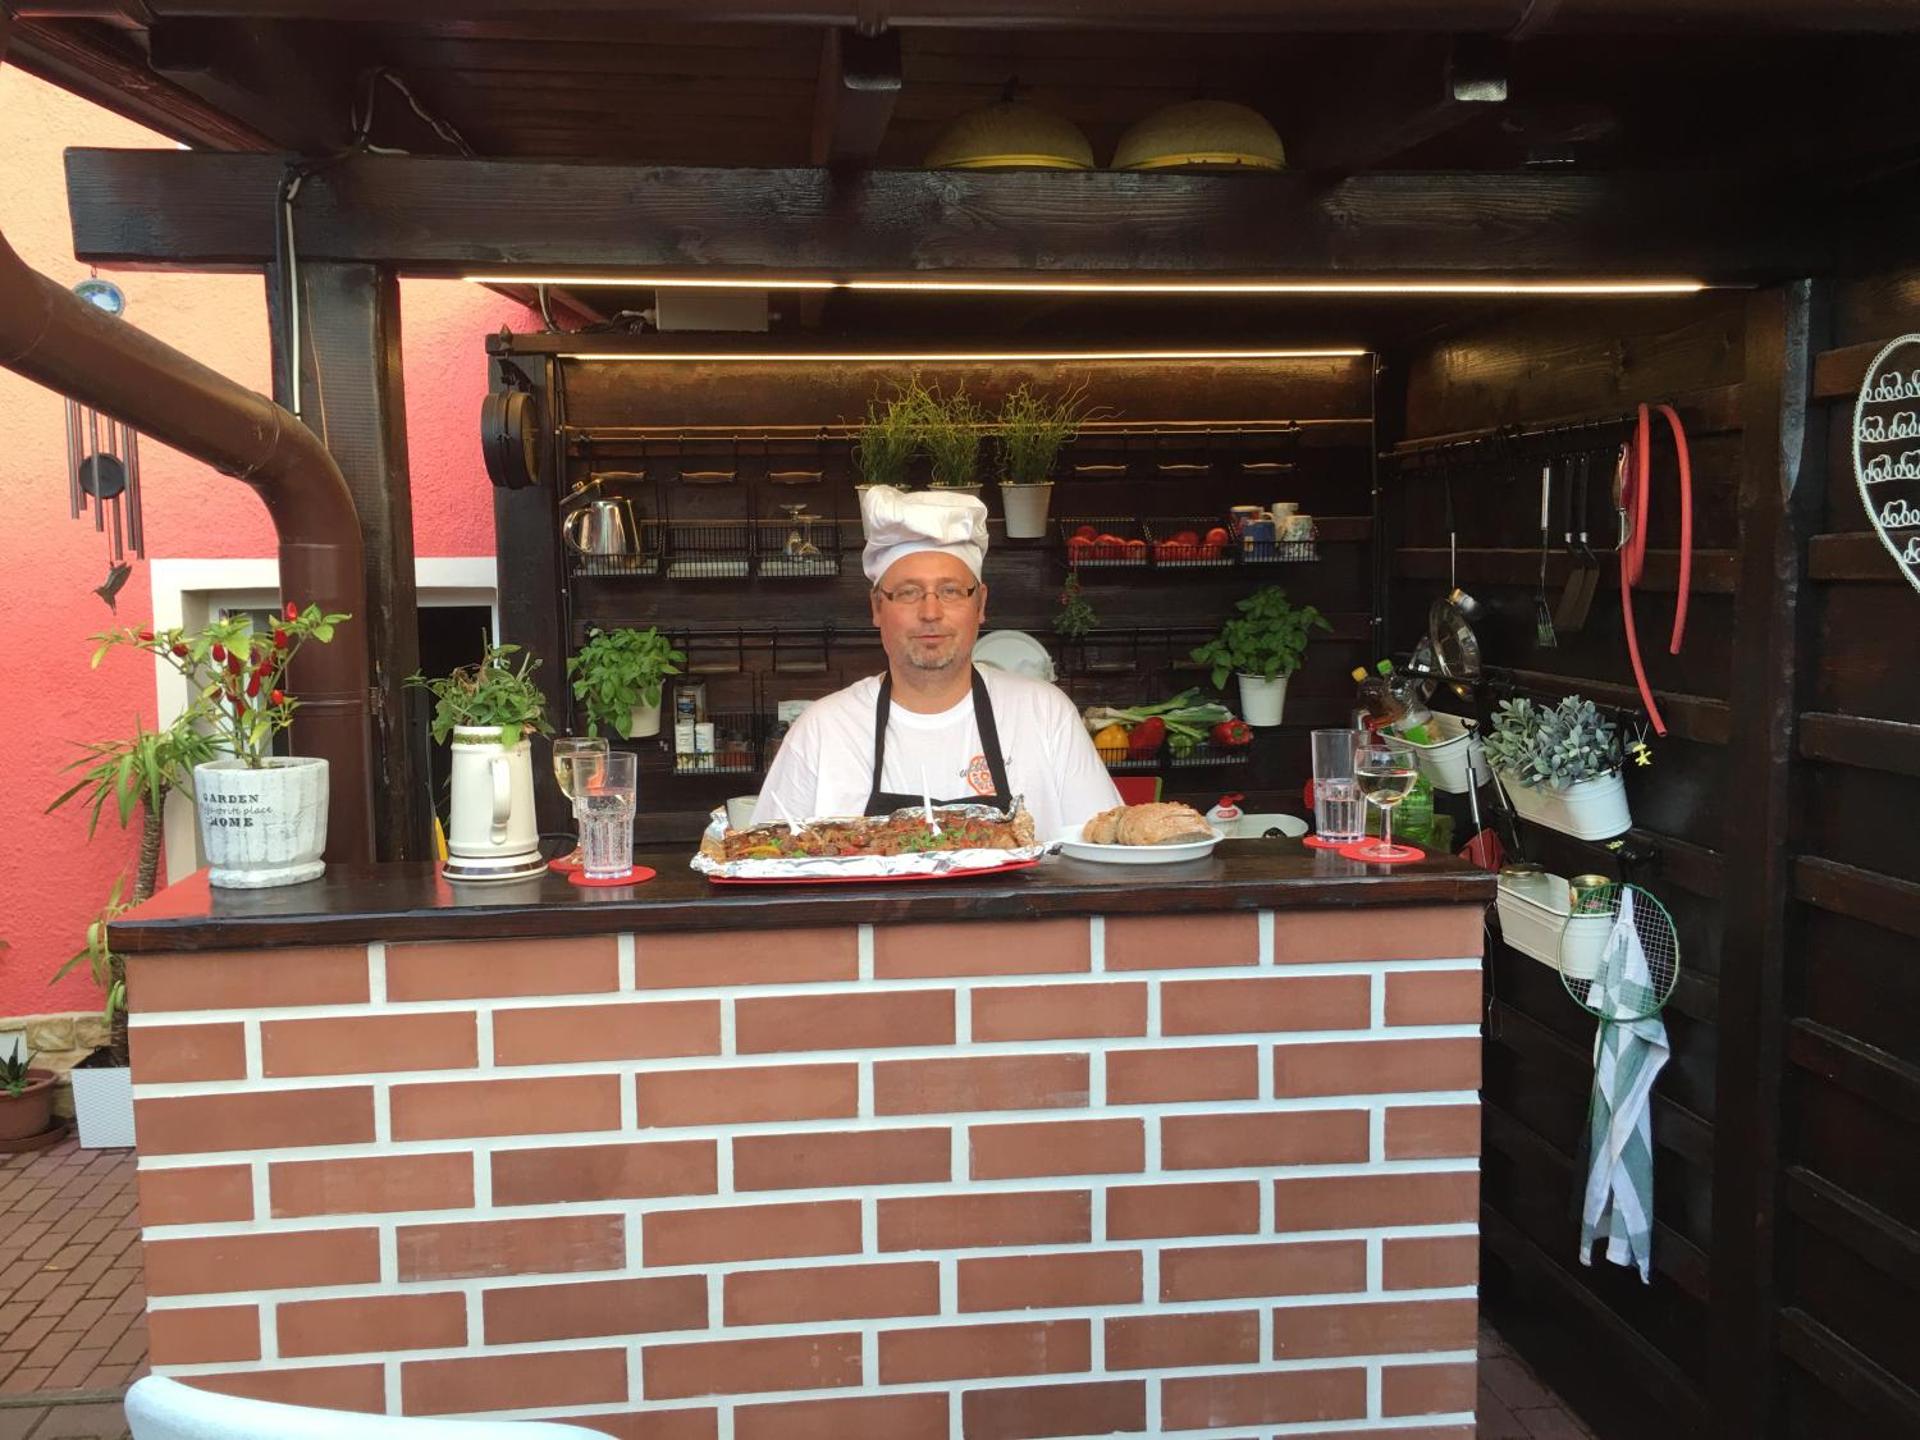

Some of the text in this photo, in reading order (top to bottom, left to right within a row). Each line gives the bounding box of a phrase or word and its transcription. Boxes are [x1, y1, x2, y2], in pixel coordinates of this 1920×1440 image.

[203, 793, 259, 804] GARDEN
[243, 805, 273, 816] place
[210, 817, 254, 827] HOME
